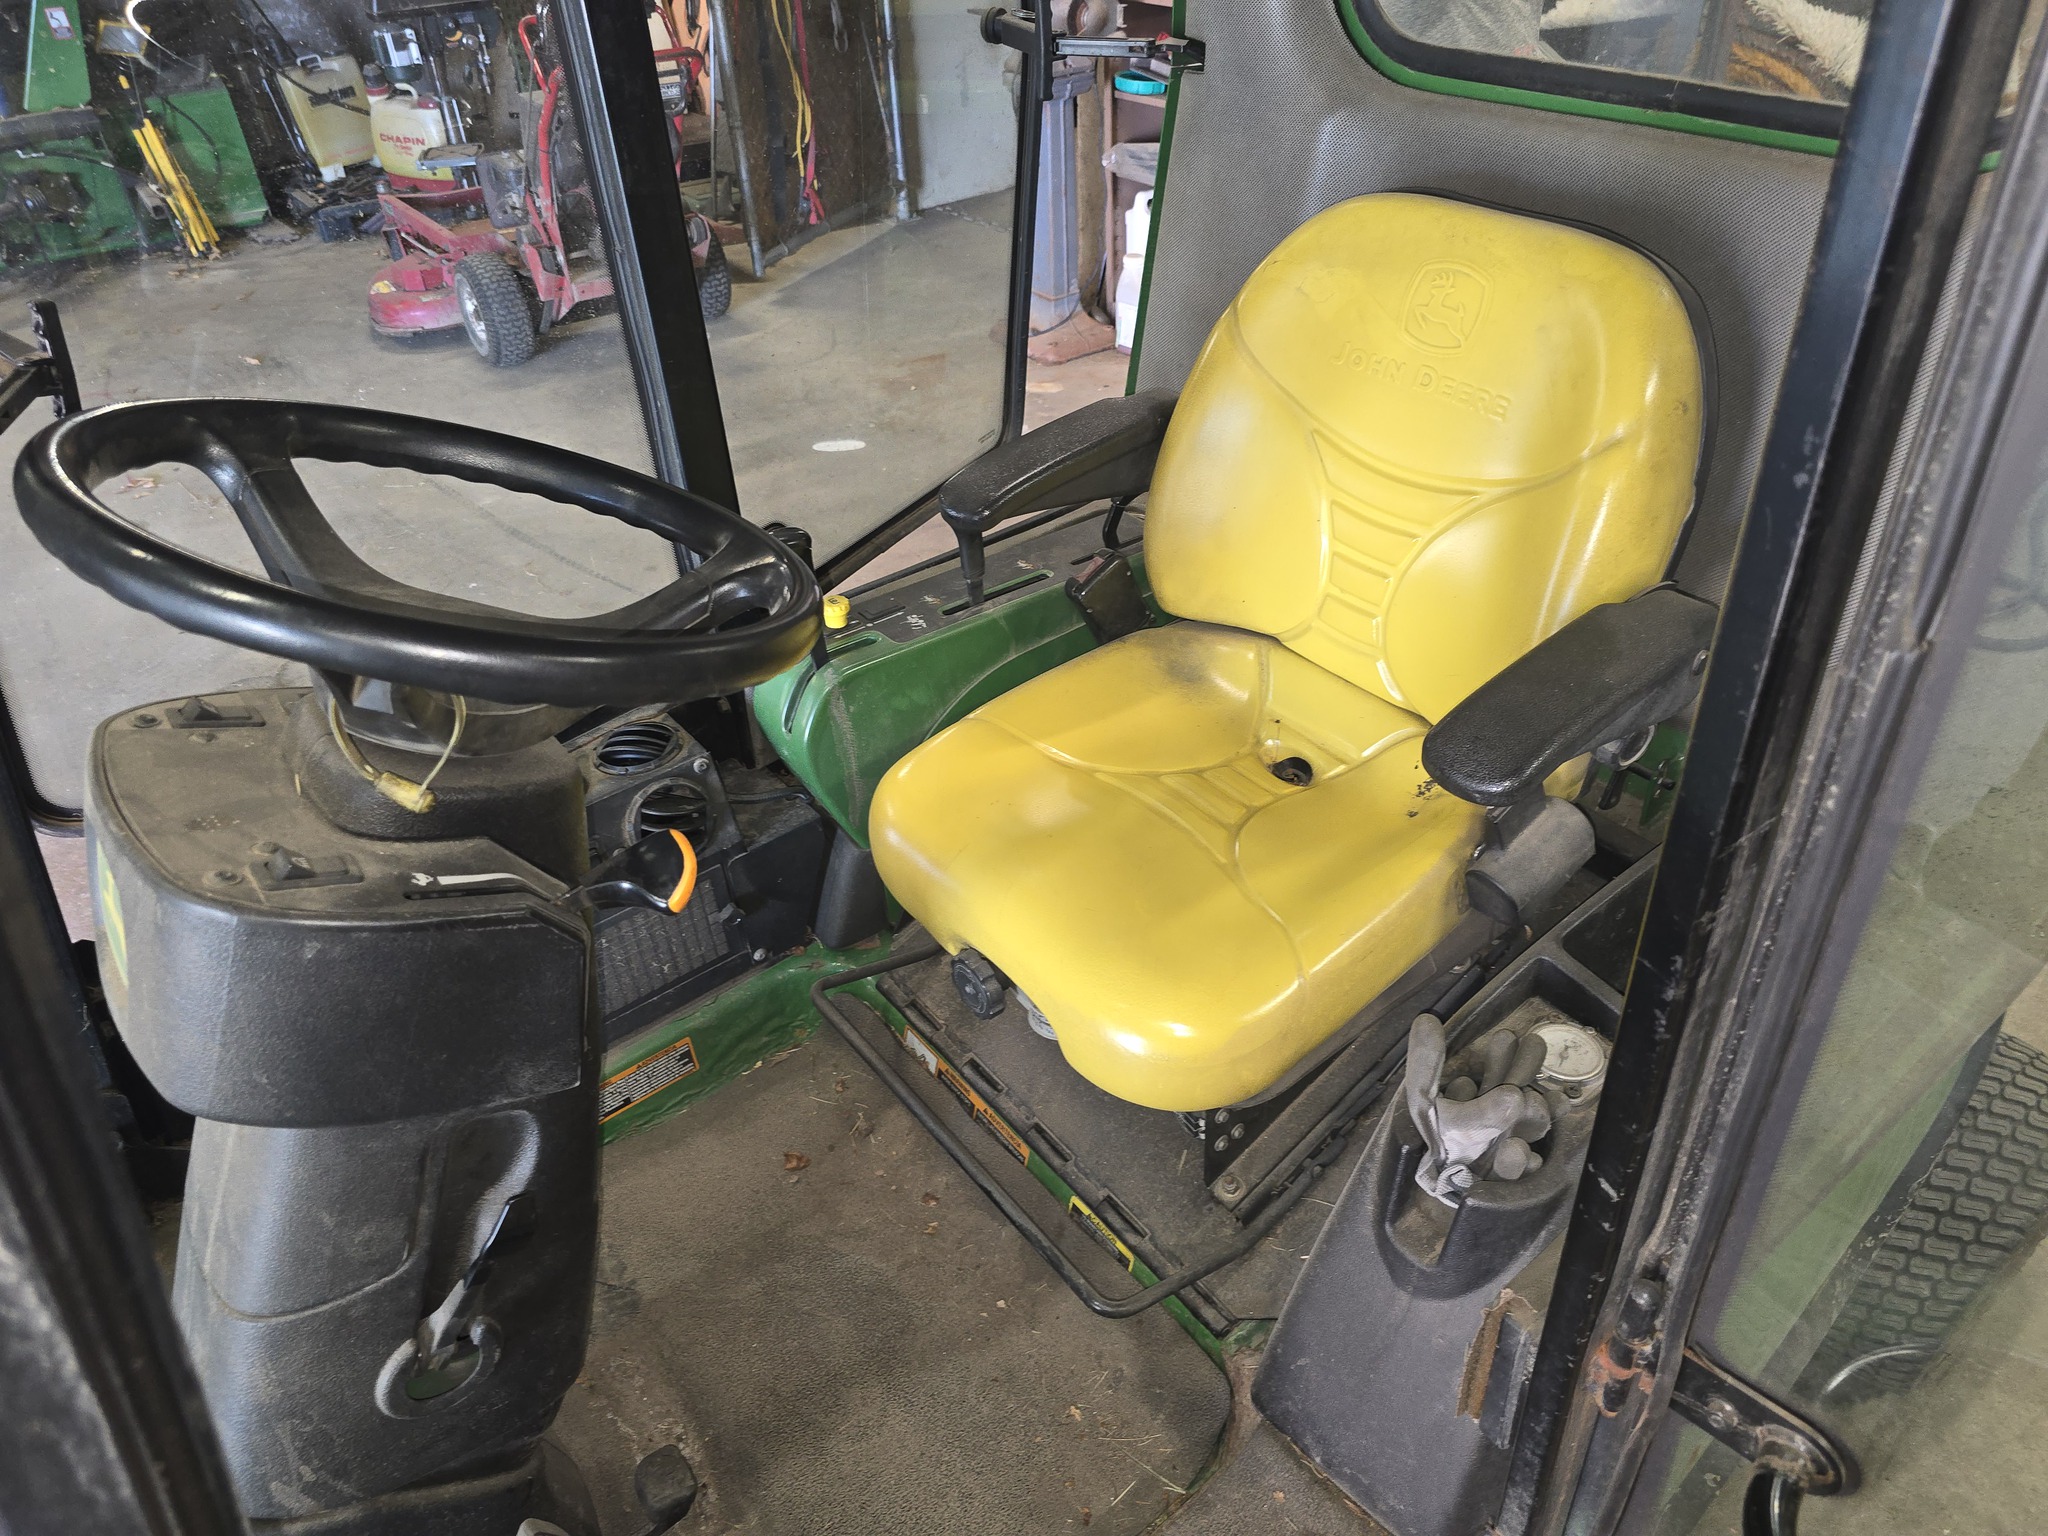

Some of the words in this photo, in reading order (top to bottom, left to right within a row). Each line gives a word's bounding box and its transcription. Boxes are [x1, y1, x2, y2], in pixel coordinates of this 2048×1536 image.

[380, 133, 426, 146] CHAPIN
[1332, 341, 1406, 385] JOHN
[1413, 364, 1513, 422] DEERE
